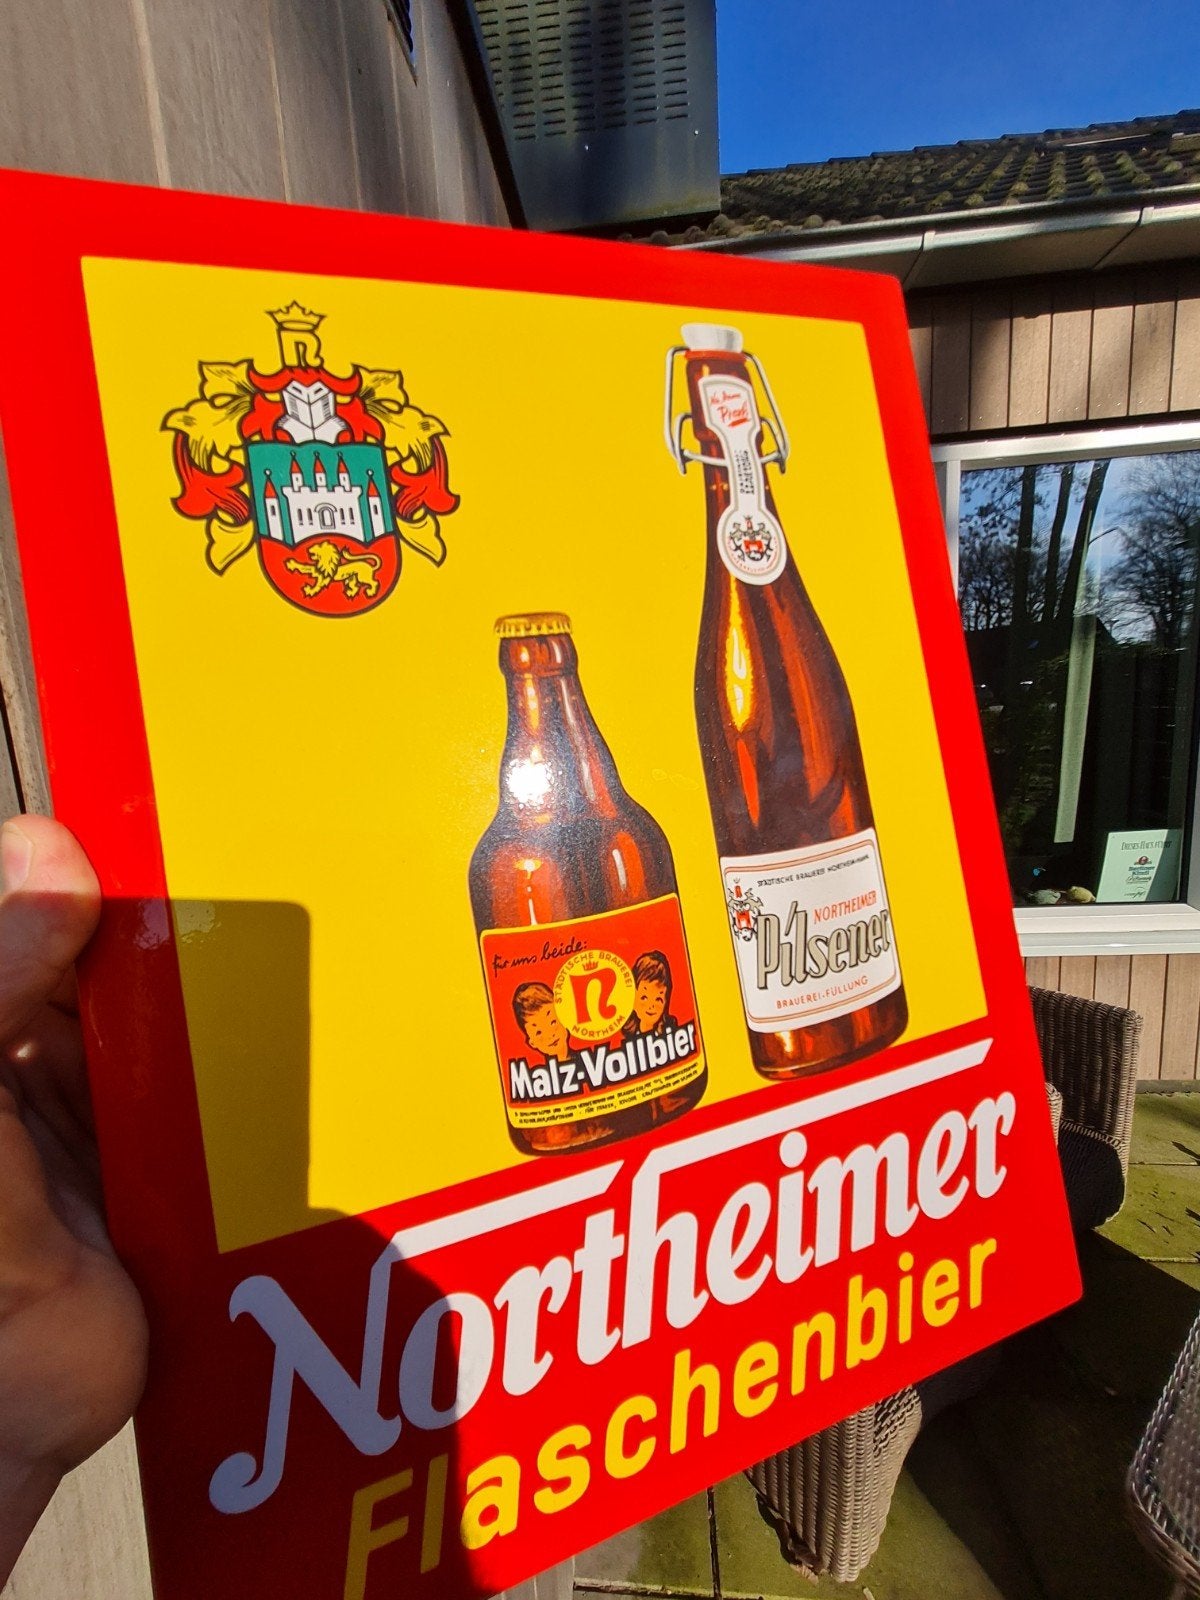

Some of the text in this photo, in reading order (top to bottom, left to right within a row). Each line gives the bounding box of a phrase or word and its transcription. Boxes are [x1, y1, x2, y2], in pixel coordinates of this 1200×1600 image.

[813, 890, 878, 924] NORTHEIMER
[511, 955, 537, 968] uns
[541, 936, 588, 961] beide:
[598, 952, 633, 988] BRAUEREI
[757, 901, 890, 989] Pilsener
[572, 1015, 626, 1038] NORTHEIM
[510, 1024, 696, 1099] Malz-Vollbier
[208, 1040, 1017, 1515] Northeimer
[344, 1238, 998, 1600] Flaschenbier
